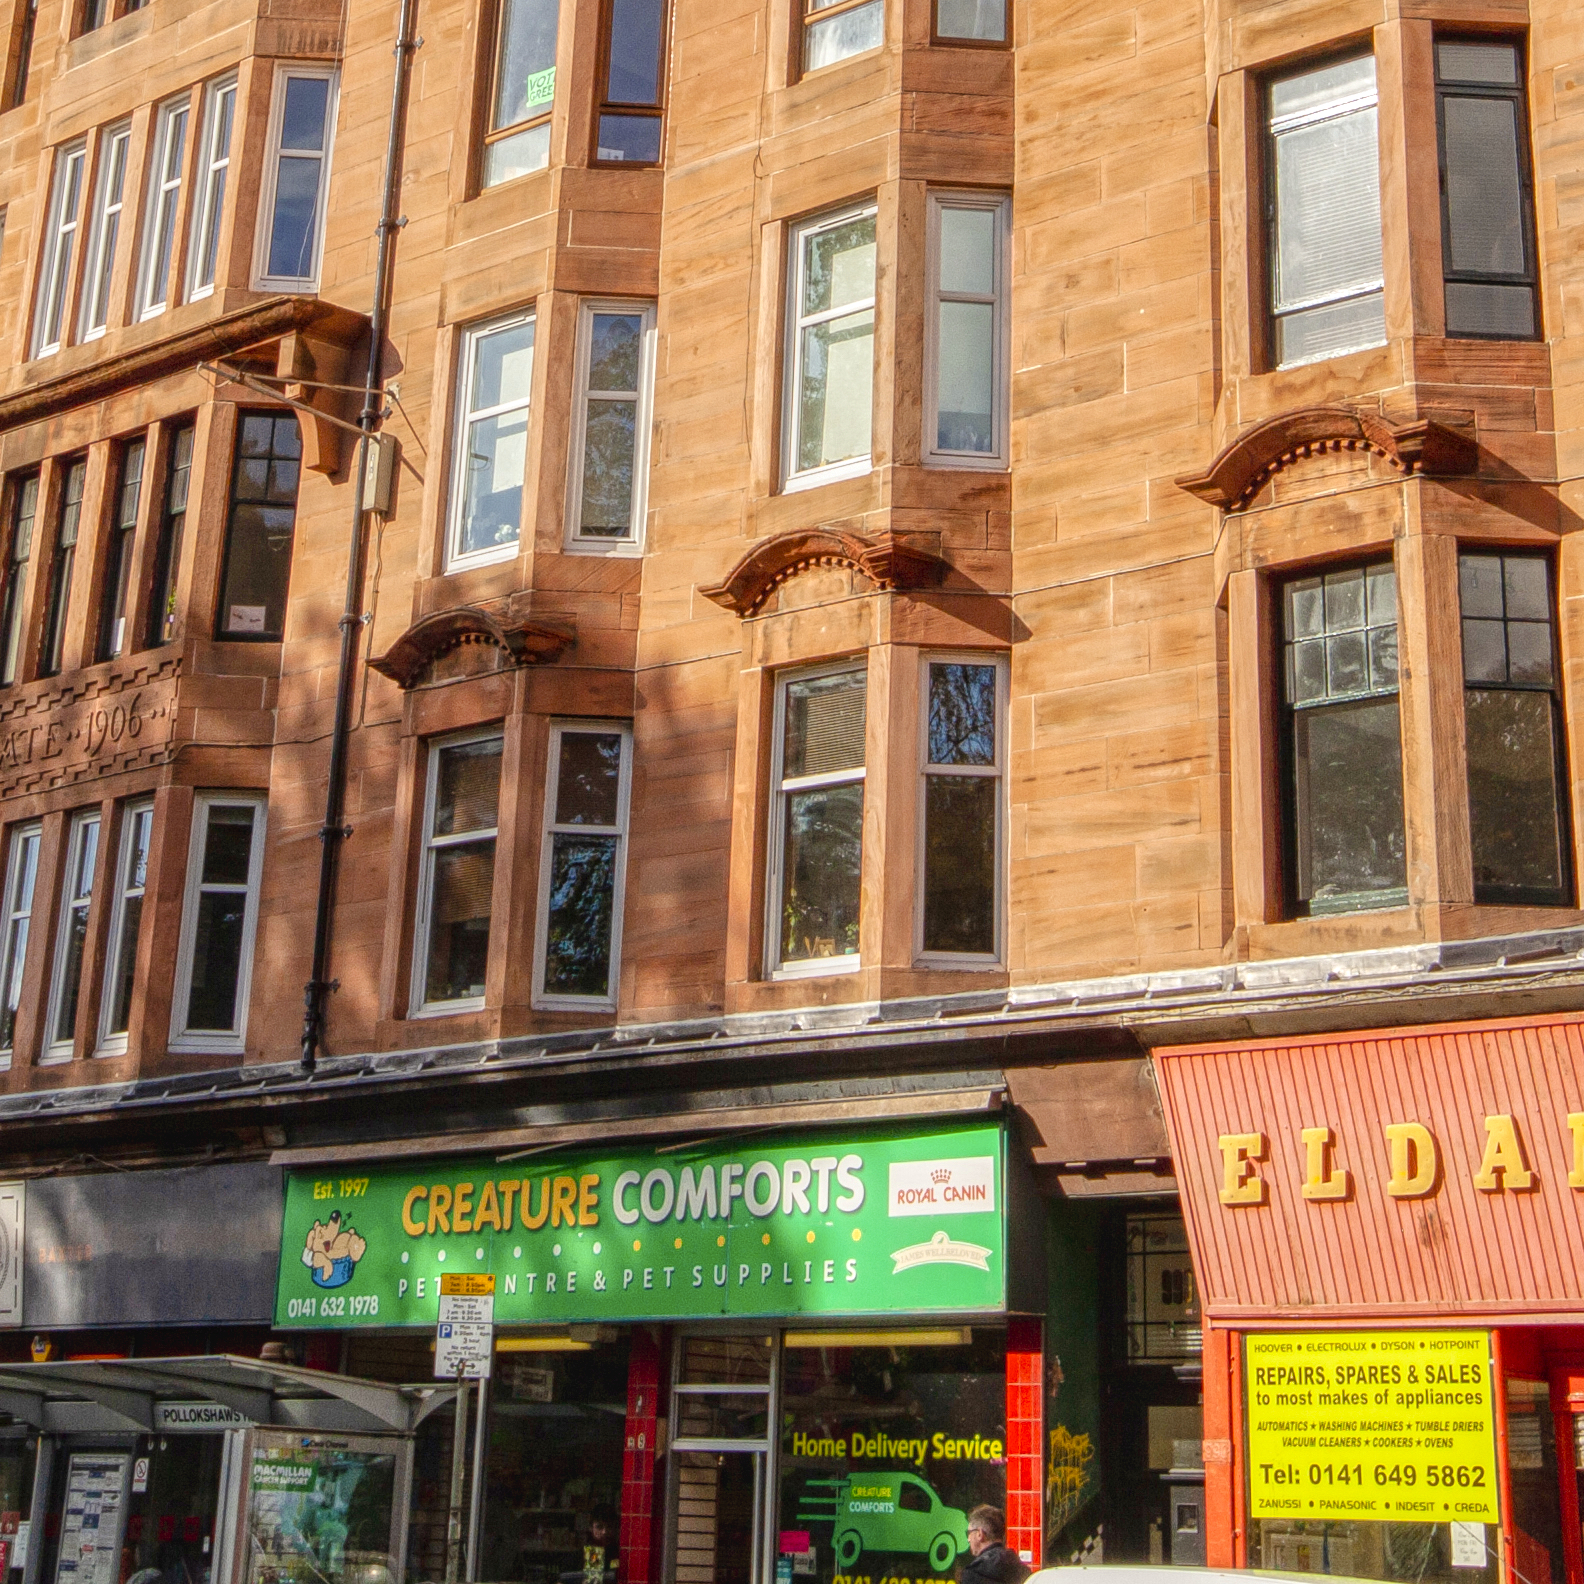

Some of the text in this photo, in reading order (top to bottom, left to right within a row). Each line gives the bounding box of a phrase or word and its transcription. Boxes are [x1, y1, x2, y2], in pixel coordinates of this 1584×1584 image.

[529, 70, 555, 91] VOT
[83, 691, 143, 758] 1906
[313, 1177, 369, 1200] Est. 1997
[401, 1153, 865, 1237] CREATURE COMFORTS
[897, 1184, 987, 1205] ROYAL CANIN
[593, 1269, 607, 1291] &
[622, 1266, 675, 1290] PET
[692, 1258, 858, 1288] SUPPLIES
[287, 1295, 379, 1318] 0141 632 1978
[441, 1325, 451, 1338] P
[1254, 1339, 1481, 1353] HOOVER ELECTROLUX DYSON HOTPOINT
[1255, 1364, 1482, 1389] REPAIRS, SPARES & SALES
[1256, 1388, 1483, 1409] to most makes of appliances
[163, 1409, 241, 1423] POLLOKSHAWS
[1257, 1421, 1484, 1432] AUTOMATICS WASHING MACHINES TUMBLE DRIERS
[792, 1432, 1003, 1466] Home Delivery Service
[1282, 1437, 1454, 1448] VACUUM CLEANERS COOKERS OVENS
[253, 1464, 313, 1478] MACMILLAN
[1259, 1463, 1486, 1488] Tel: 0141 649 5862
[851, 1486, 892, 1498] CREATURE
[849, 1501, 895, 1514] COMFORTS
[1258, 1498, 1490, 1514] ZANUSSI PANASONIC INDESIT CREDA
